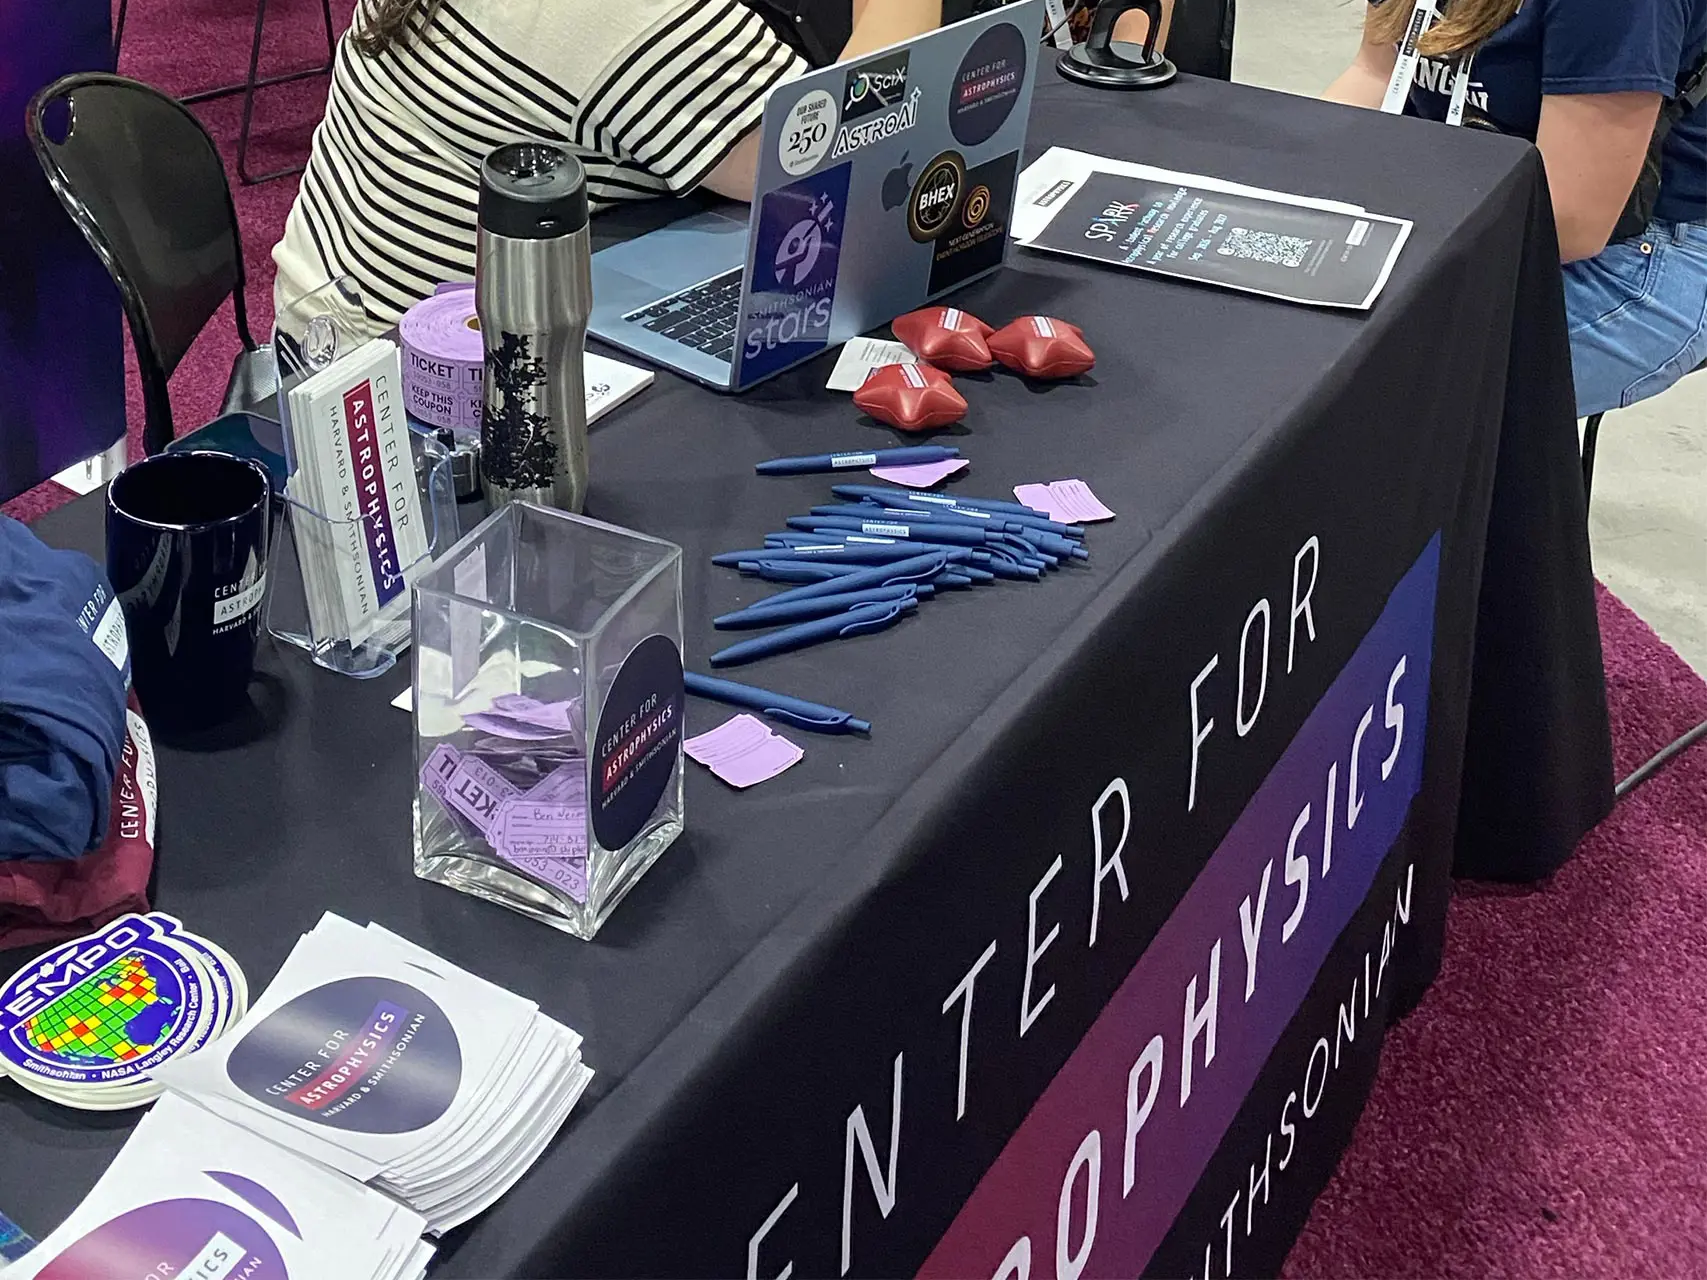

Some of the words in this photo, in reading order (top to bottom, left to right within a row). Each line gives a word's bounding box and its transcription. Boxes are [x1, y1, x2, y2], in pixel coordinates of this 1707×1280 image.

[961, 65, 990, 83] CENTER
[991, 59, 1006, 71] FOR
[962, 71, 1015, 98] ASTROPHYSICS
[787, 122, 827, 155] 250
[919, 183, 955, 211] BHEX
[1084, 200, 1140, 243] SPARK
[744, 296, 832, 360] stars
[410, 352, 455, 379] TICKET
[411, 384, 430, 398] KEEP
[431, 392, 454, 406] THIS
[412, 394, 452, 415] COUPON
[328, 406, 347, 480] HARVARD
[374, 374, 399, 472] CENTER
[391, 482, 411, 532] FOR
[340, 485, 350, 497] &
[351, 398, 398, 592] ASTROPHYSICS
[342, 500, 370, 615] SMITHSONIAN
[212, 616, 247, 635] HARVARD
[601, 713, 637, 758] CENTER
[639, 692, 658, 719] FOR
[605, 704, 673, 781] ASTROPHYSICS
[121, 735, 134, 769] FO
[601, 776, 629, 811] HARVARD
[635, 728, 678, 773] SMITHSONIAN
[453, 778, 500, 821] KET
[746, 776, 1132, 1280] ENTER
[1187, 534, 1320, 812] FOR
[0, 926, 140, 1031] EMPO
[173, 957, 191, 975] Ball
[187, 982, 199, 1012] Center
[171, 1011, 196, 1053] Research
[22, 1057, 87, 1081] Smithsonian
[101, 1064, 136, 1081] NASA
[135, 1040, 174, 1074] Langley
[264, 1060, 321, 1097] CENTER
[317, 1028, 350, 1060] FOR
[299, 1010, 396, 1106] ASTROPHYSICS
[320, 1091, 363, 1118] HARVARD
[360, 1084, 371, 1095] &
[370, 1012, 427, 1087] SMITHSONIAN
[187, 1246, 229, 1280] ICS
